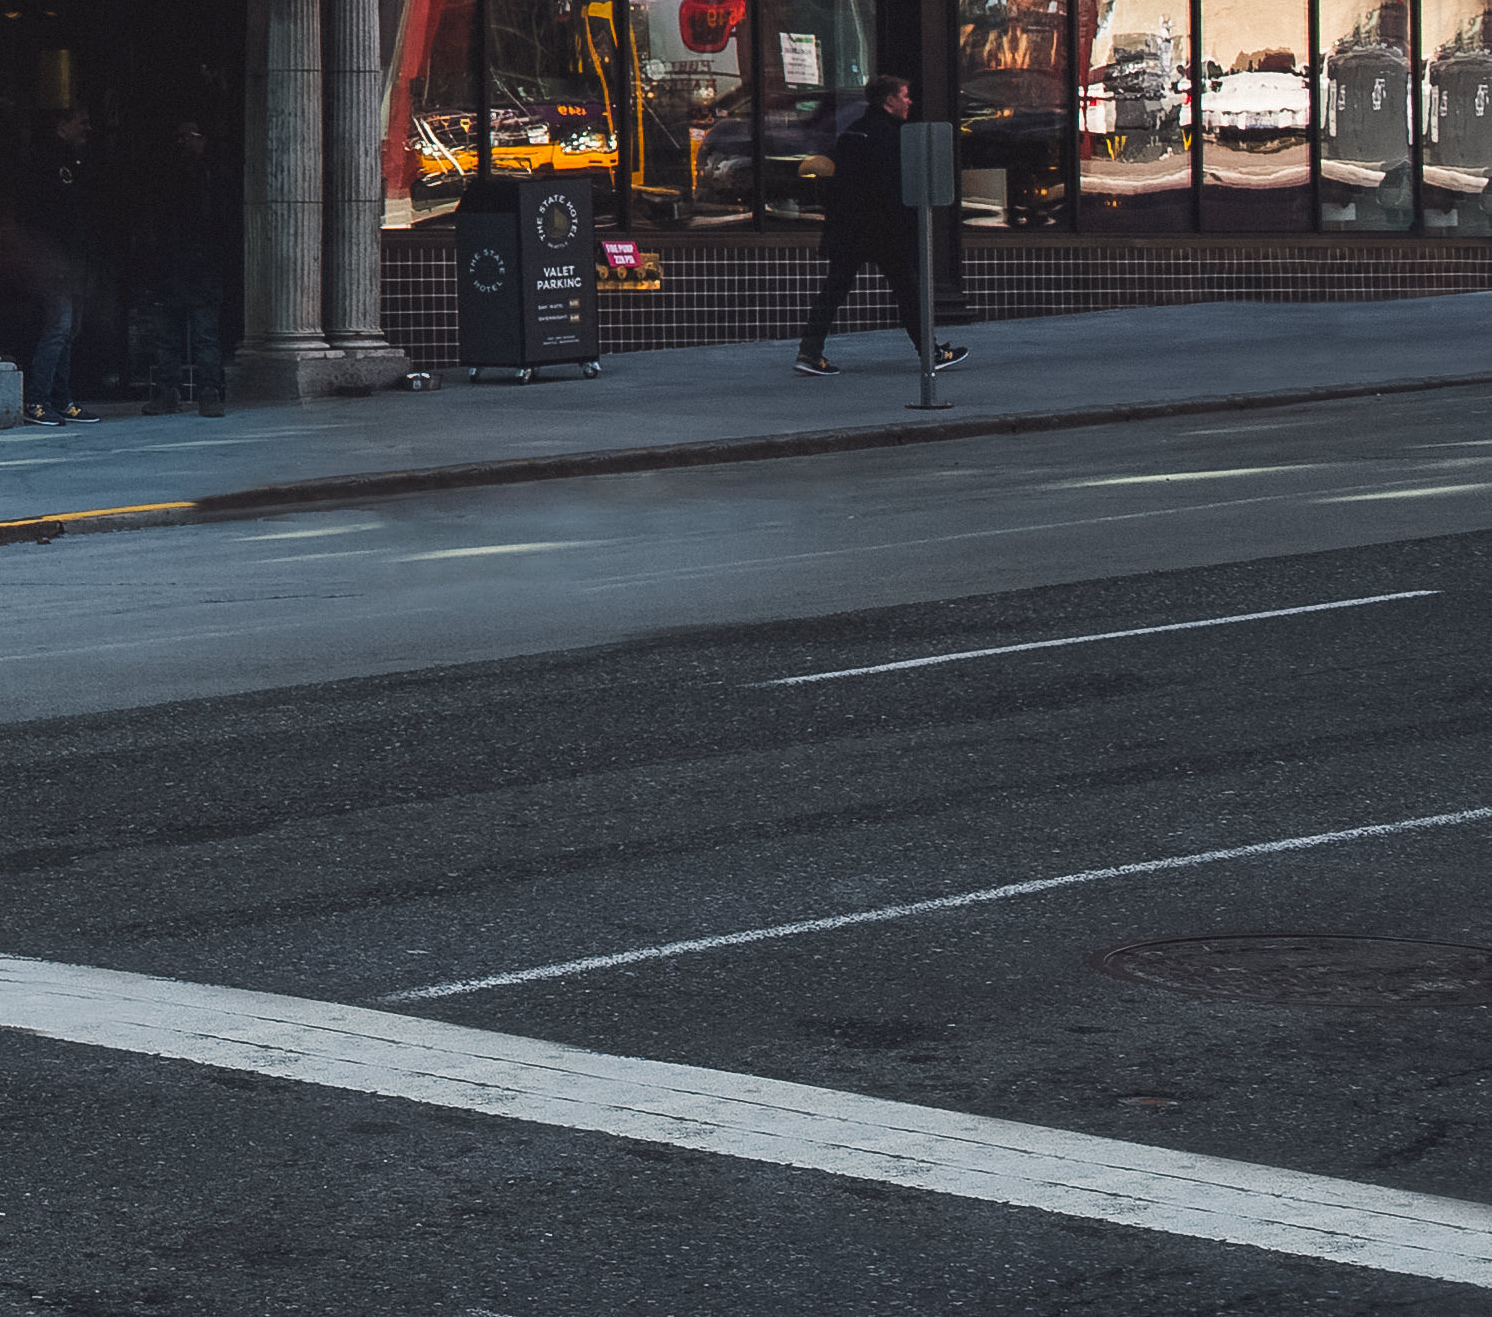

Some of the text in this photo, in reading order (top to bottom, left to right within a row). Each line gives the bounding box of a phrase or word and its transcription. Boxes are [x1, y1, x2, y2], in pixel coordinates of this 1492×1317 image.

[536, 194, 579, 242] THE STATE HOTEL
[470, 248, 506, 274] THE STATE
[543, 265, 575, 278] VALET
[472, 279, 504, 294] HOTEL
[535, 277, 583, 291] PARKING
